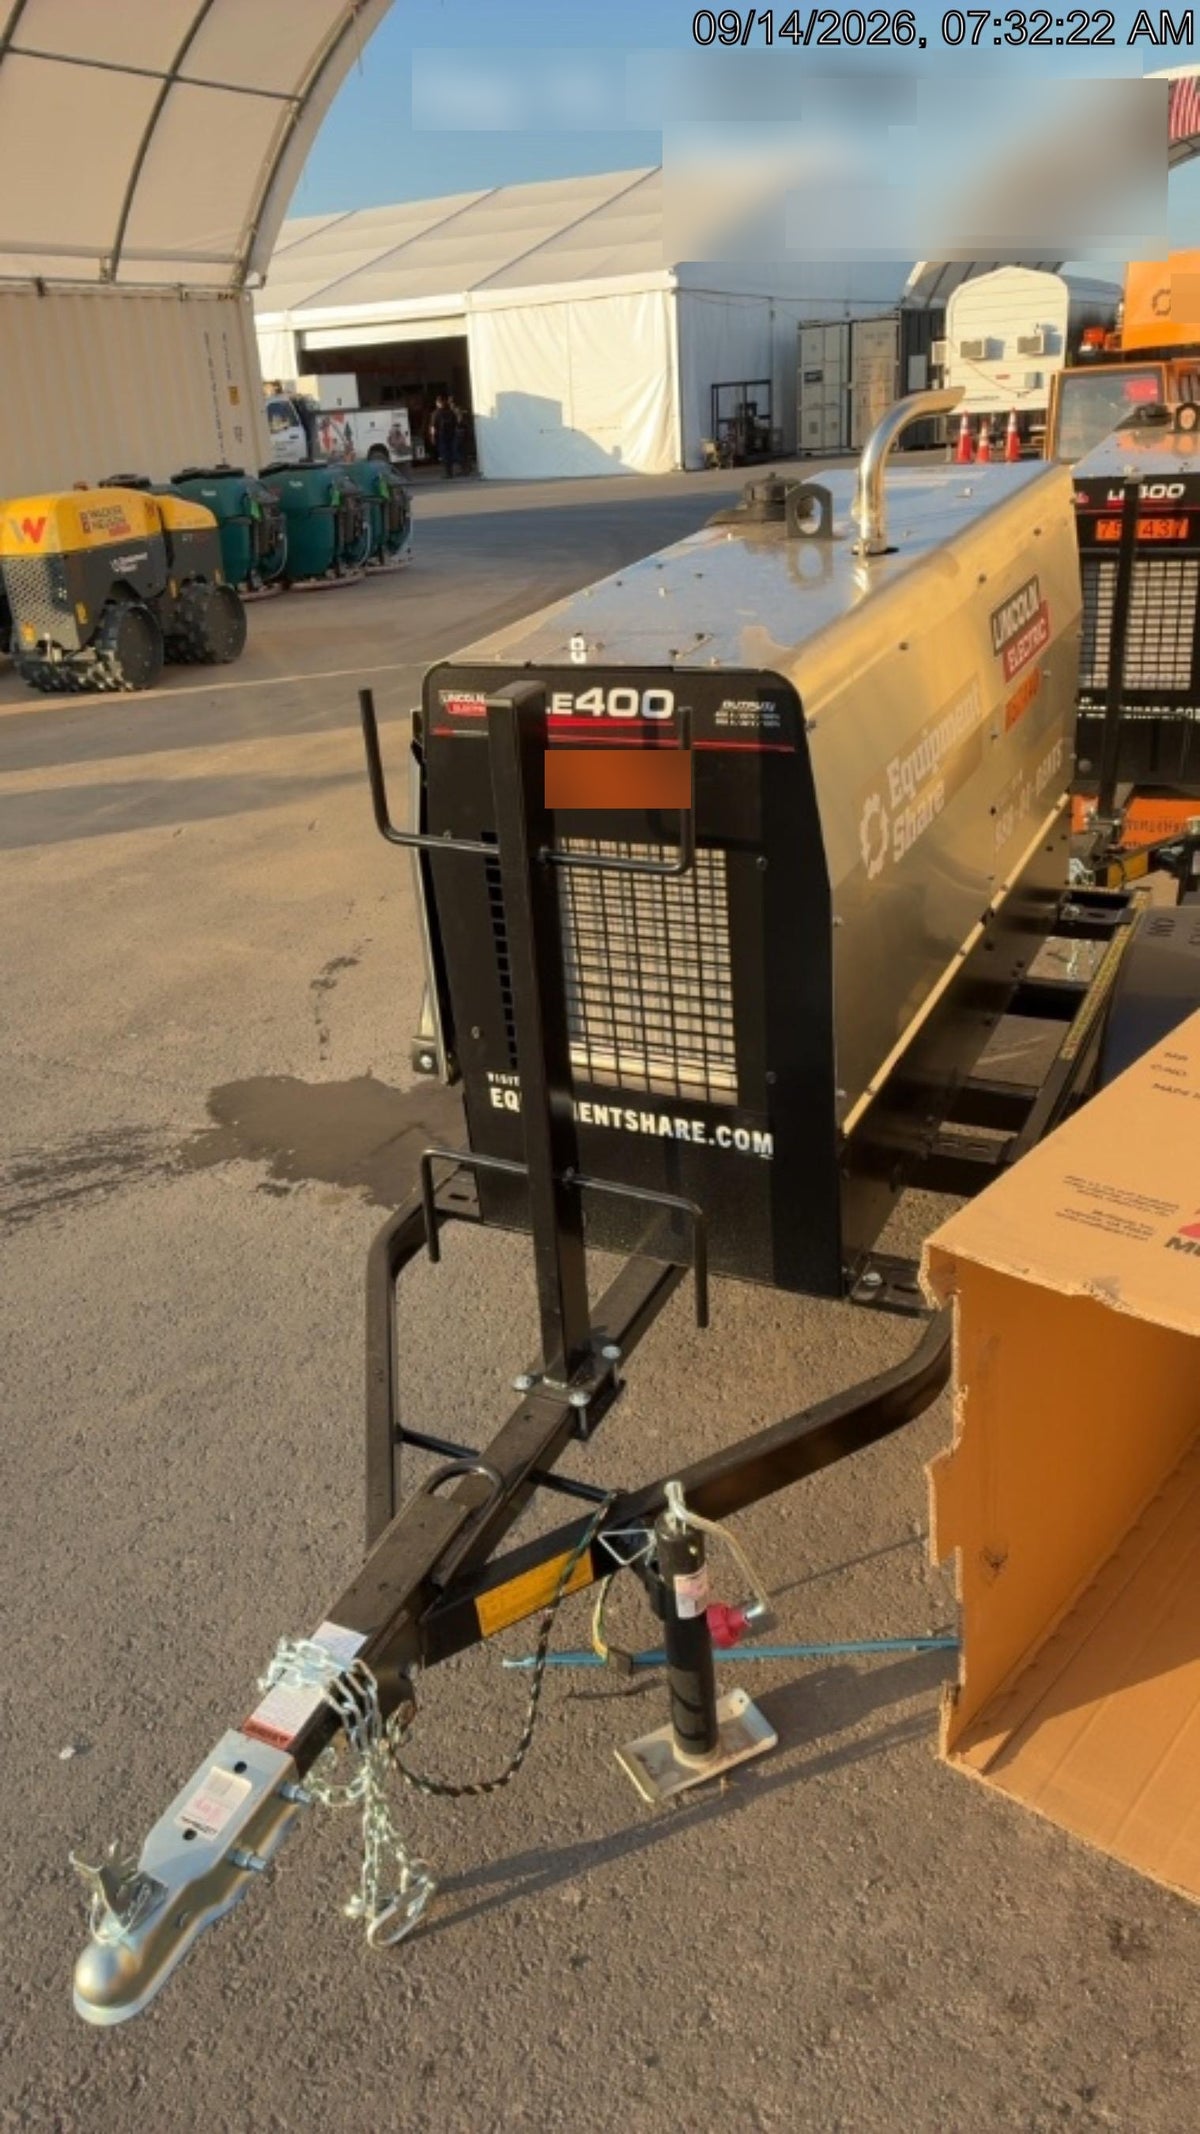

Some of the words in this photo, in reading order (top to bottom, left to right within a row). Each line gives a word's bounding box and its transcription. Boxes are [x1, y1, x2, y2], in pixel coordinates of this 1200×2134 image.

[993, 577, 1041, 652] LINCOLN
[1006, 616, 1048, 674] ELECTRIC
[887, 682, 981, 811] Equipment
[893, 778, 946, 863] Share
